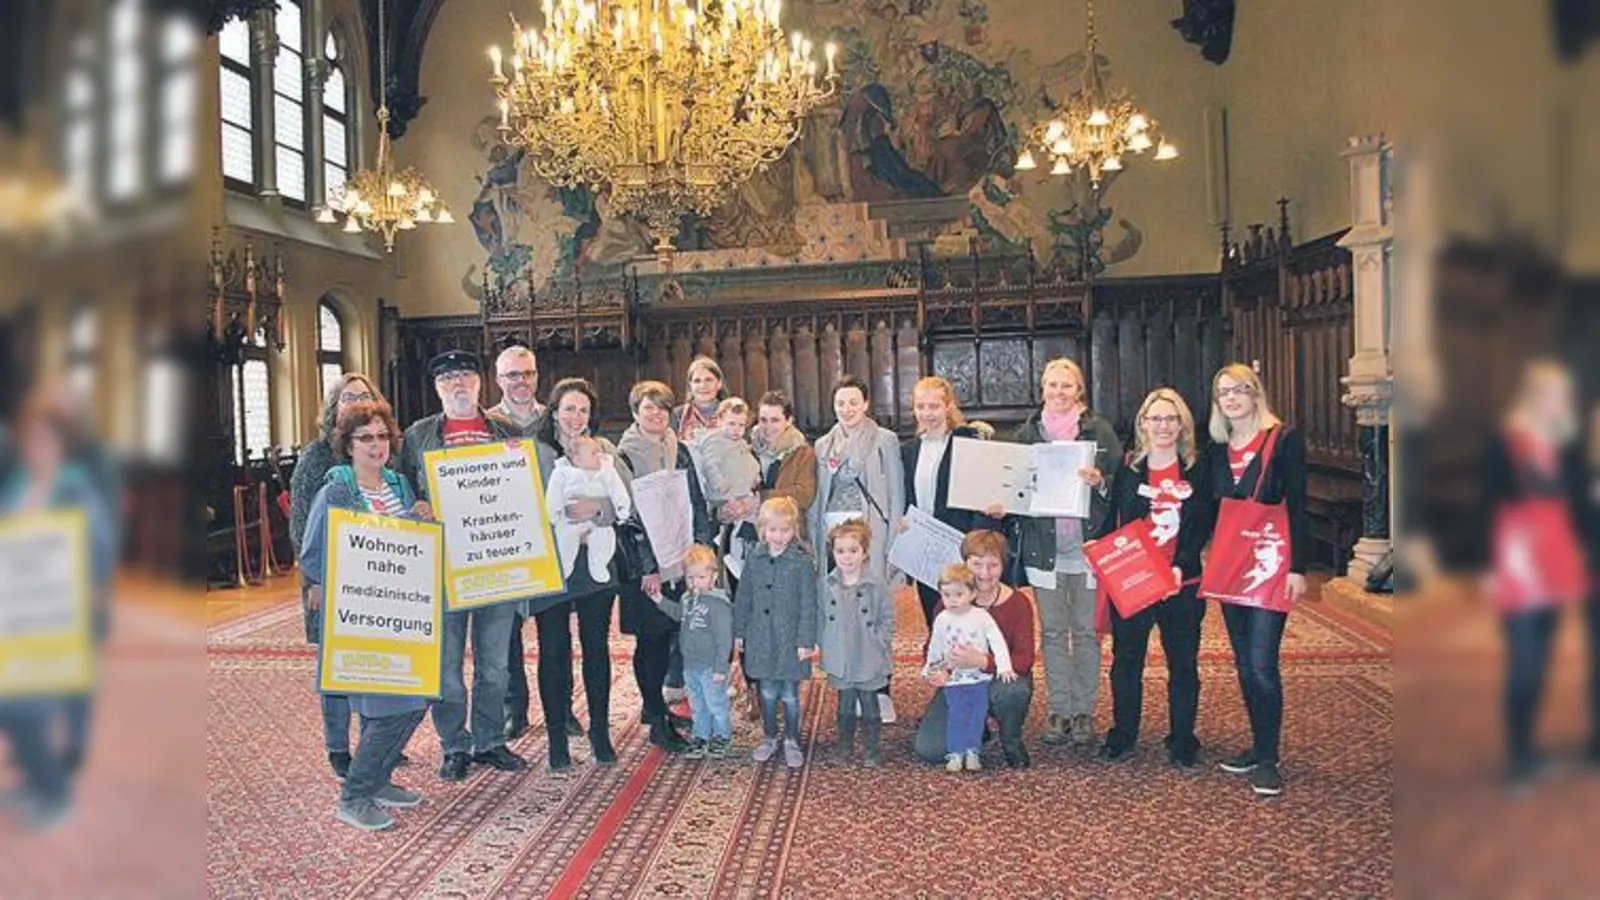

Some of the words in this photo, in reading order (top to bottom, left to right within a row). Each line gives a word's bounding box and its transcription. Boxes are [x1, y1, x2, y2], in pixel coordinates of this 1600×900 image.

[438, 461, 498, 477] Senioren
[501, 457, 527, 470] und
[457, 476, 501, 490] Kinder
[479, 493, 498, 505] für
[462, 512, 523, 528] Kranken-
[470, 528, 516, 543] häuser
[349, 534, 423, 557] Wohnort-
[465, 552, 483, 562] zu
[485, 545, 520, 557] teuer
[524, 541, 532, 550] ?
[367, 560, 407, 575] nahe
[342, 584, 431, 603] medizinische
[338, 608, 433, 636] Versorgung
